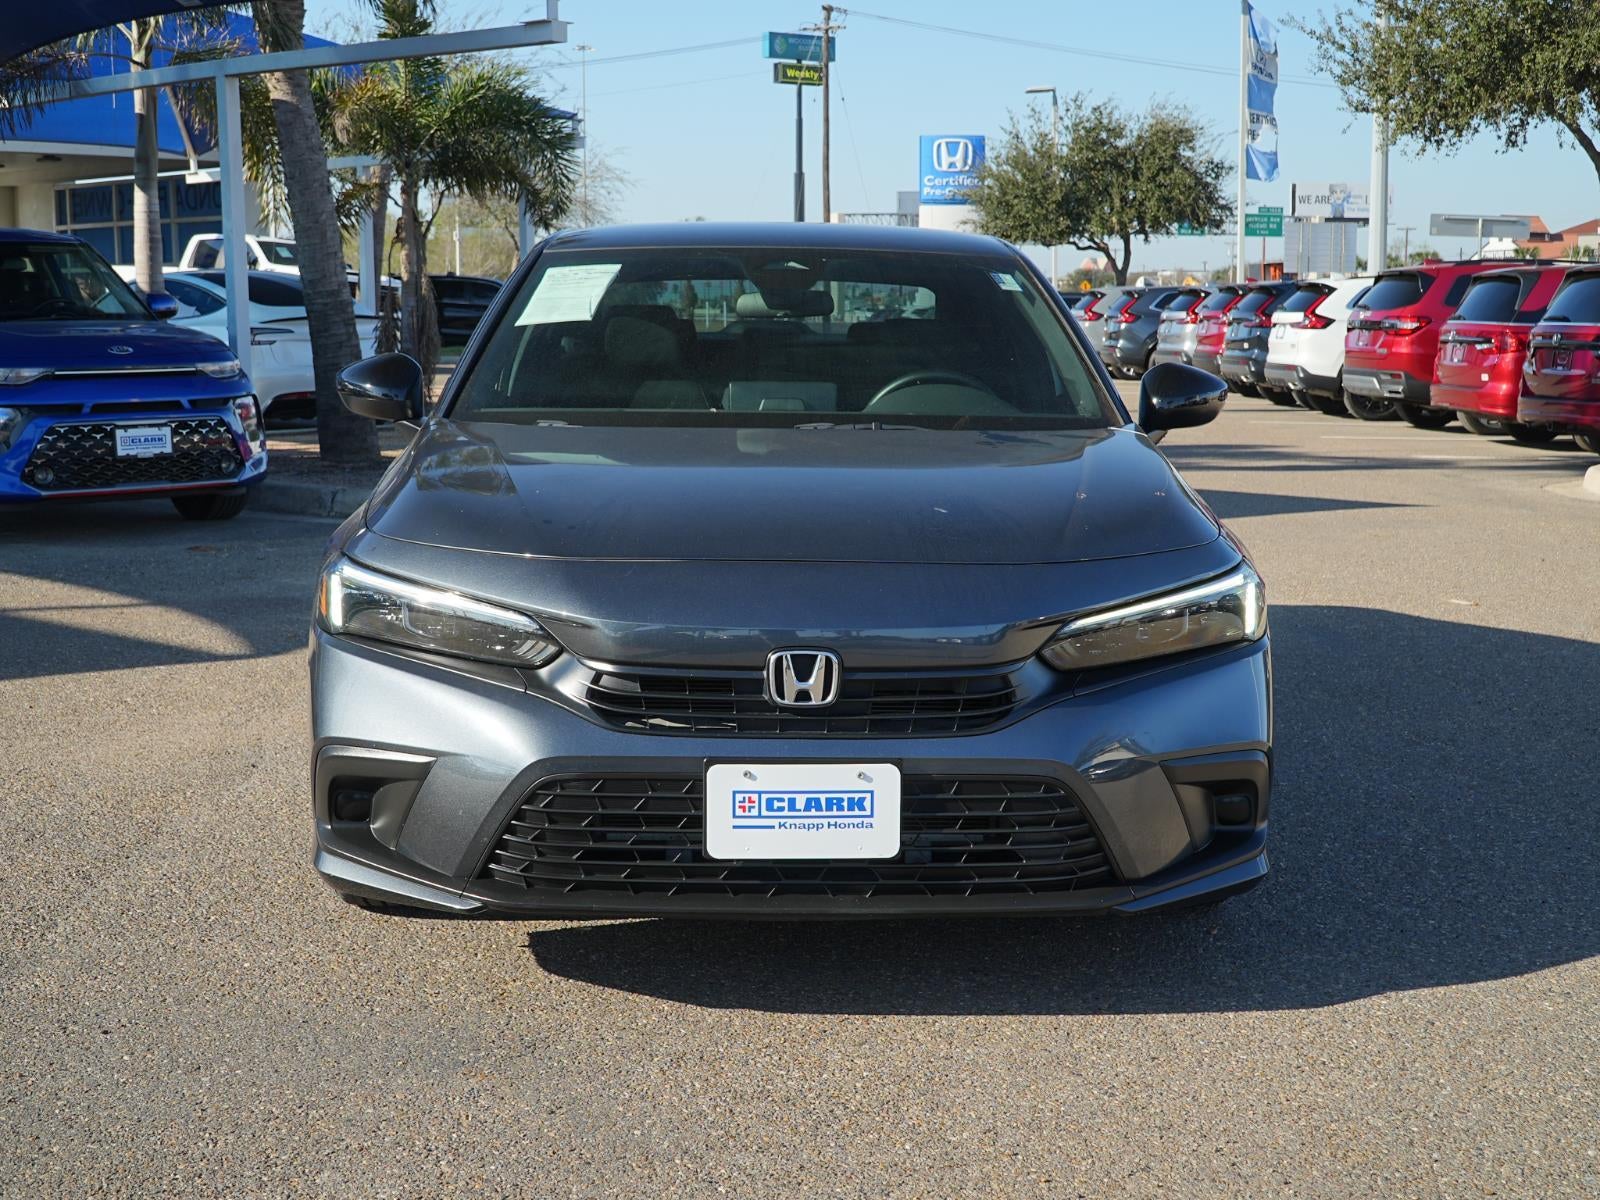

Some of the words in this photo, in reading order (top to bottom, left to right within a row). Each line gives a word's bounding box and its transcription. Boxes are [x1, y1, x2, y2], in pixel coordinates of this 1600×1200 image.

[786, 68, 819, 80] Weekly
[1298, 195, 1312, 204] WE
[1314, 195, 1332, 204] ARE
[131, 436, 164, 444] CLARK
[765, 797, 867, 812] CLARK
[778, 821, 824, 831] Knapp
[827, 820, 874, 830] Honda
